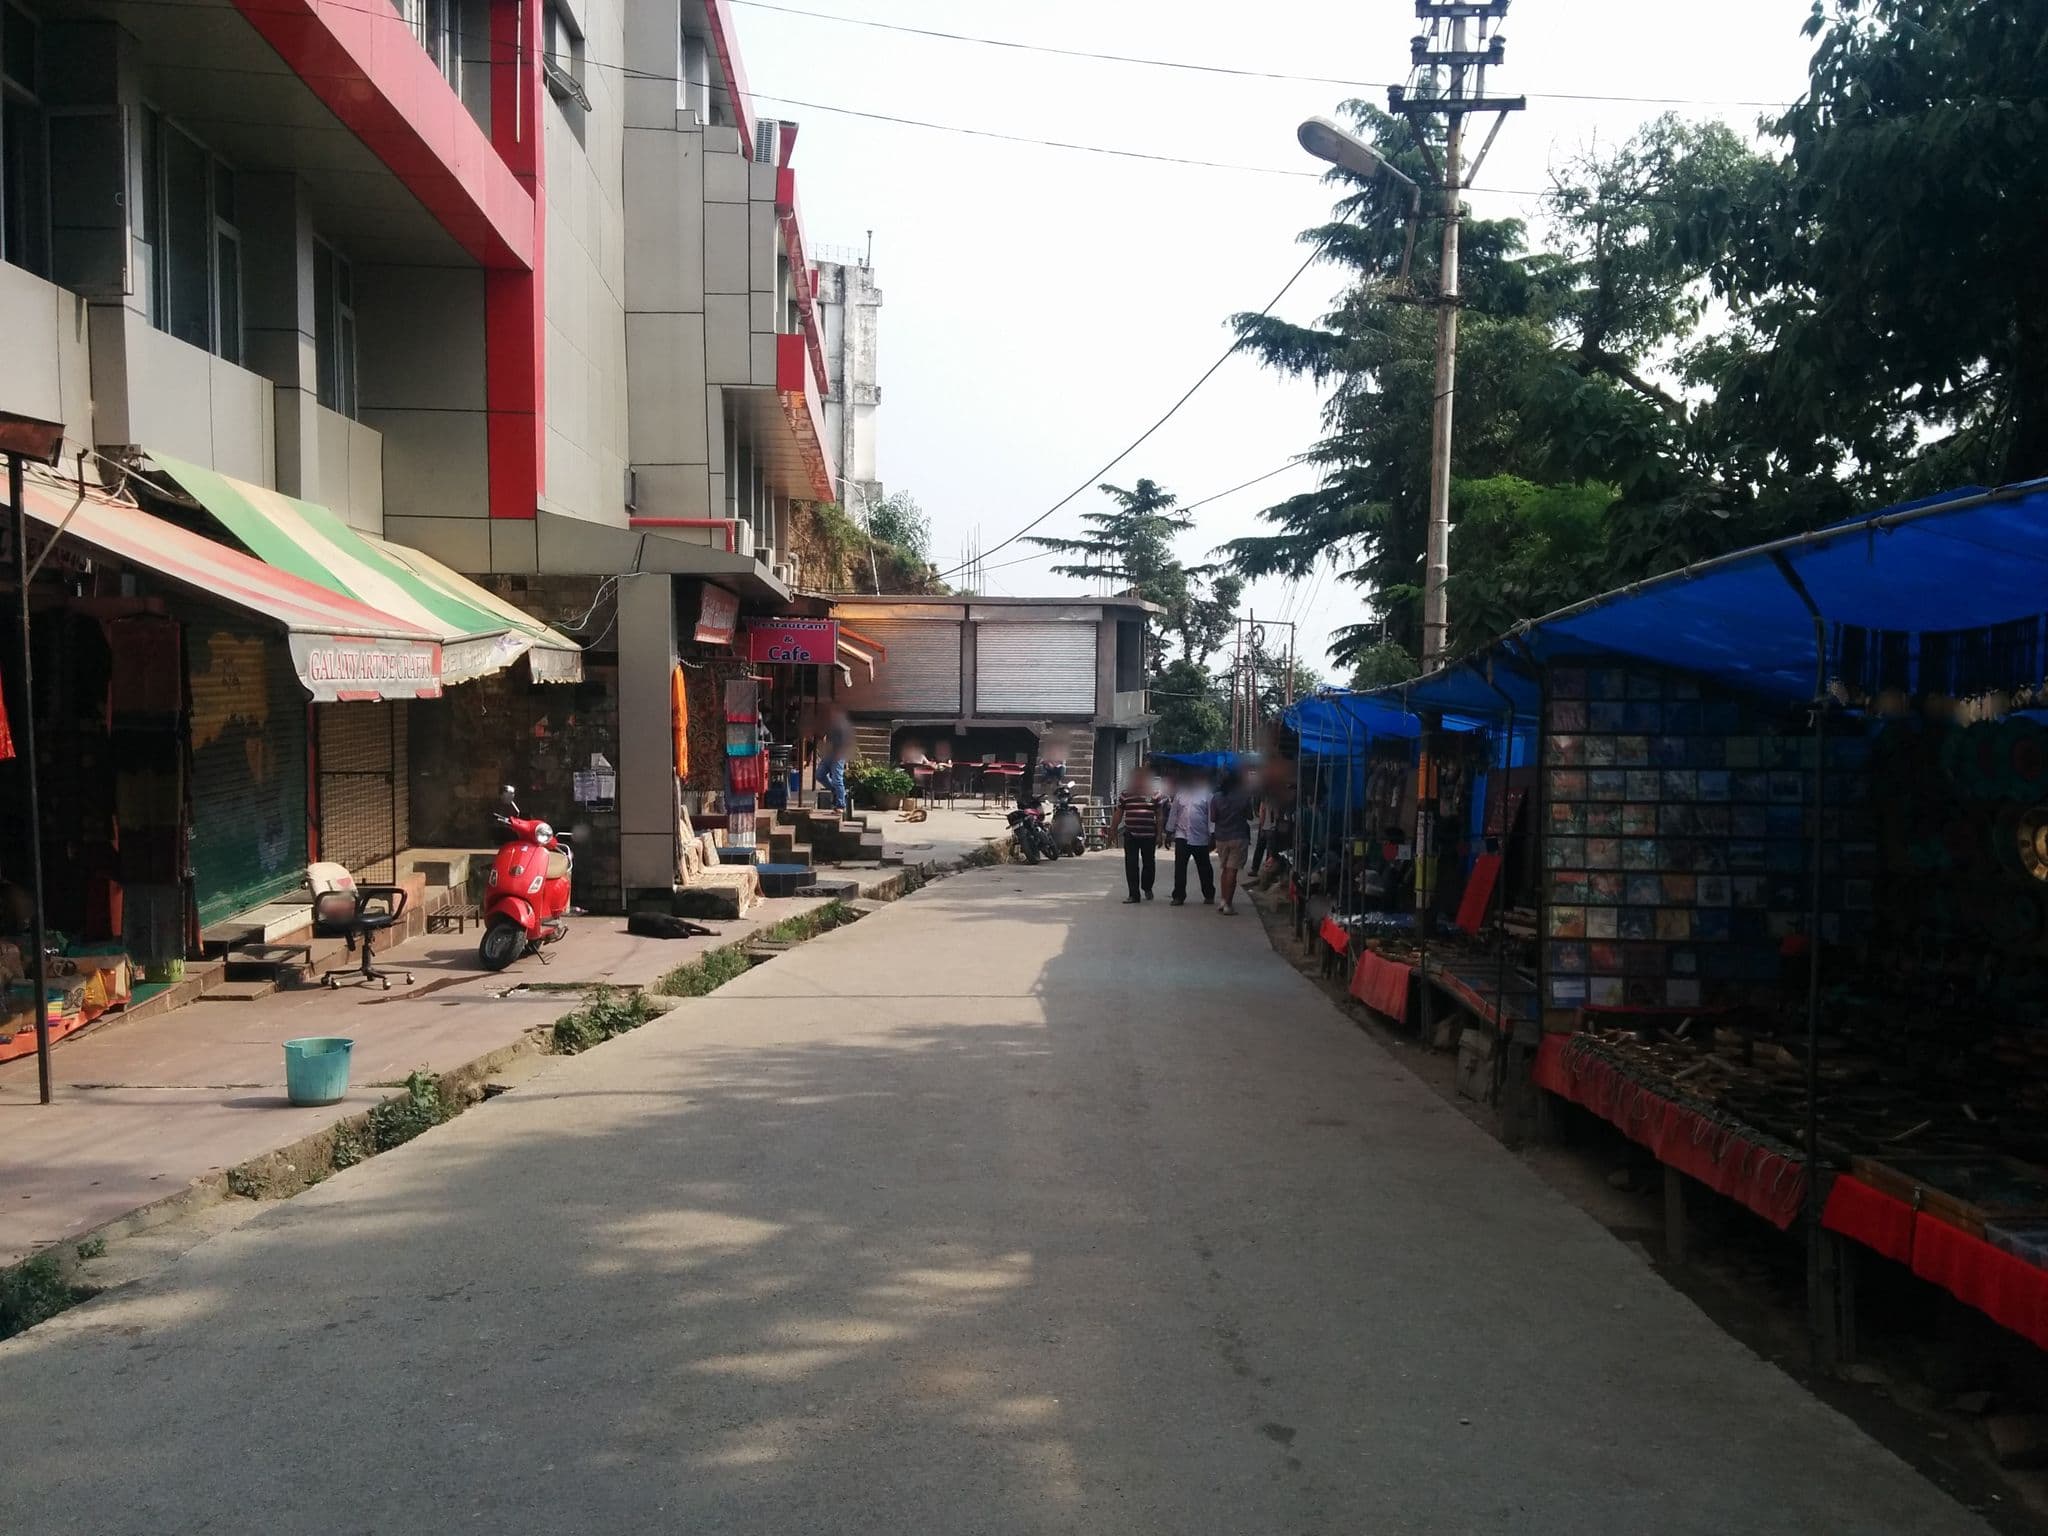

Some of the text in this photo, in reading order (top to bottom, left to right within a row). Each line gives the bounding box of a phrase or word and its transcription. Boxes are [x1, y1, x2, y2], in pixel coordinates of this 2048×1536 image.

[768, 646, 810, 661] Cafe
[359, 653, 381, 680] ART
[396, 655, 432, 680] CRAFTS
